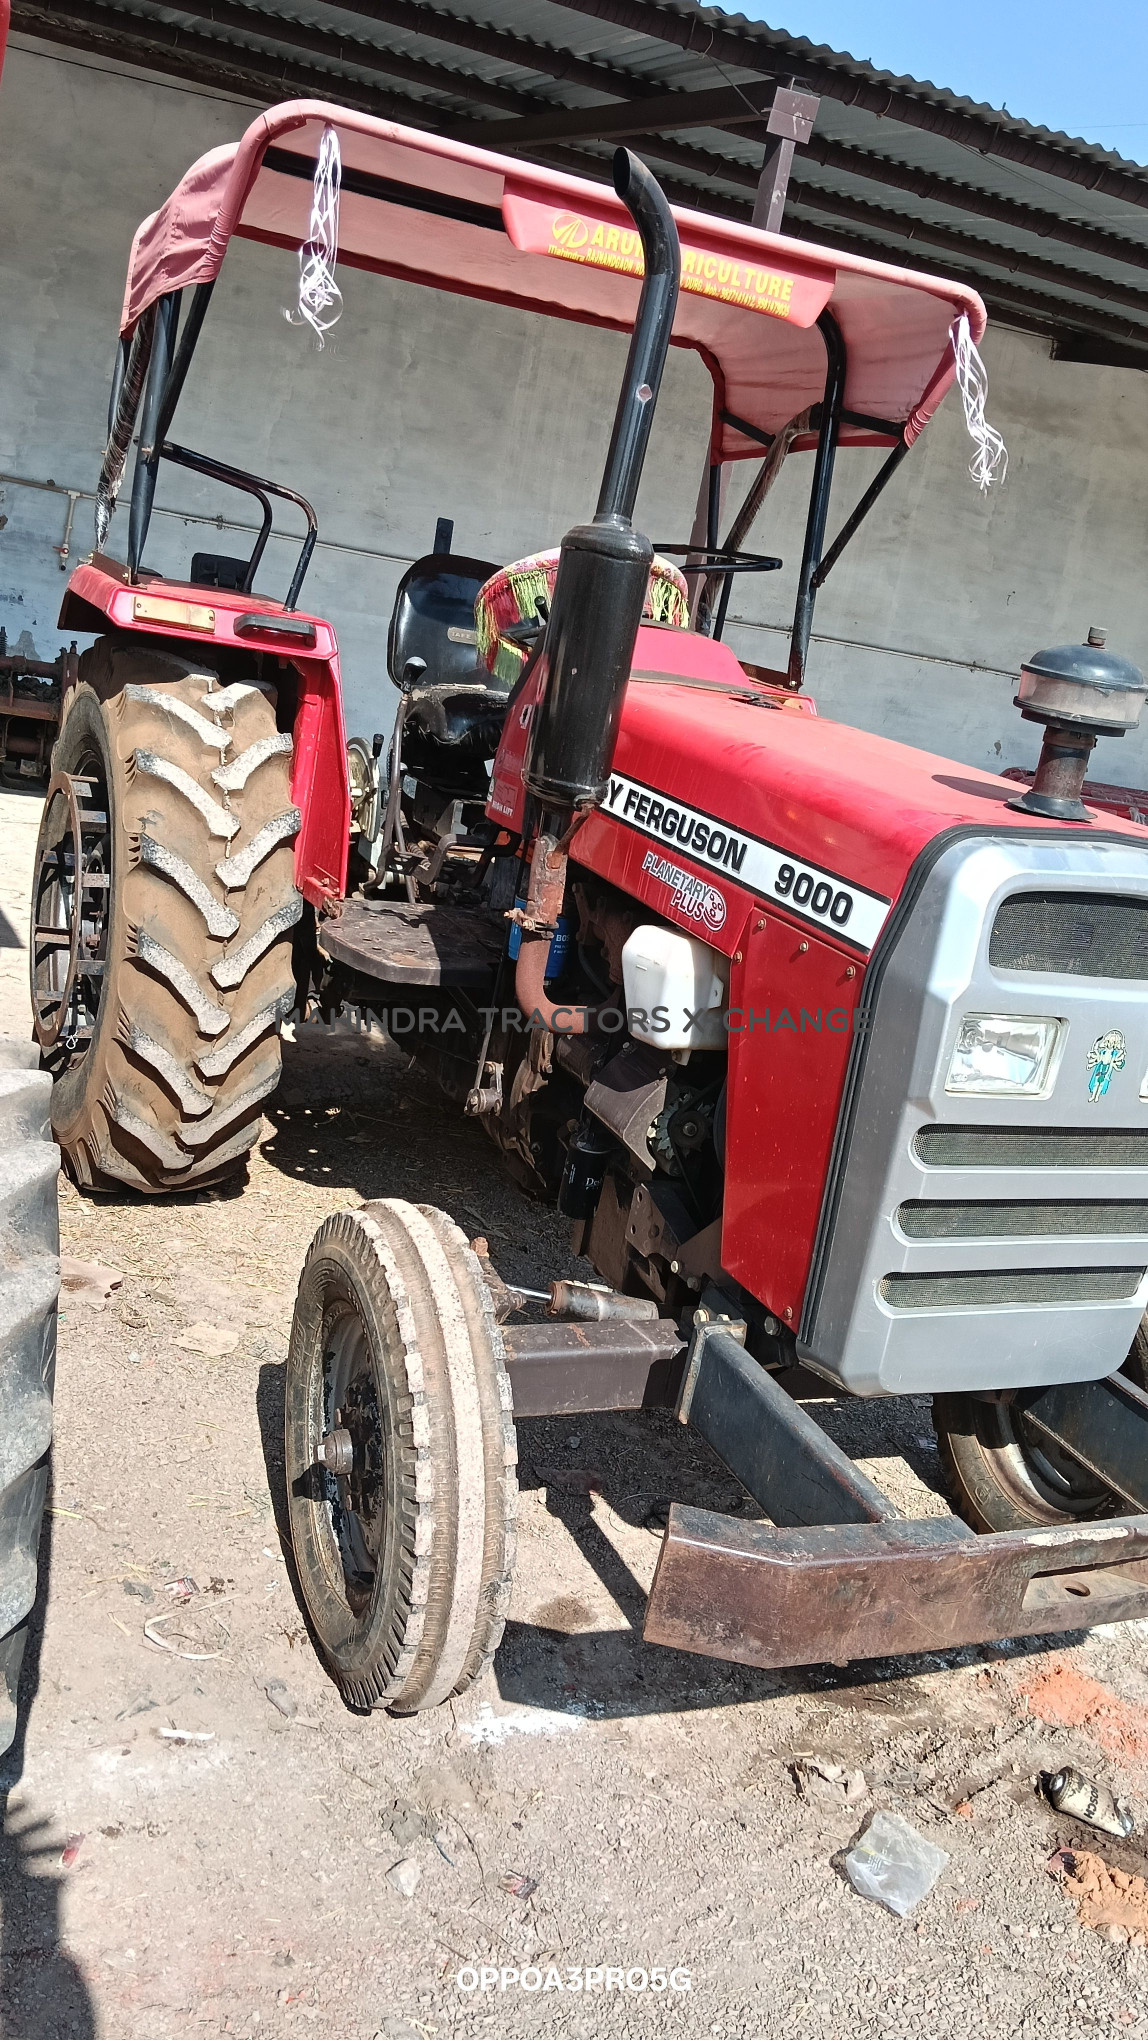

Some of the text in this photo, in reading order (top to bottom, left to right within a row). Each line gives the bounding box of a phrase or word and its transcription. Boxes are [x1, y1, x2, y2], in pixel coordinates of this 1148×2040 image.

[682, 251, 794, 301] RICULTURE
[623, 788, 748, 874] FERGUSON
[774, 863, 853, 928] 9000
[642, 850, 712, 902] PLANETARY
[670, 888, 705, 921] PLUS
[1084, 1785, 1098, 1819] BOSCH
